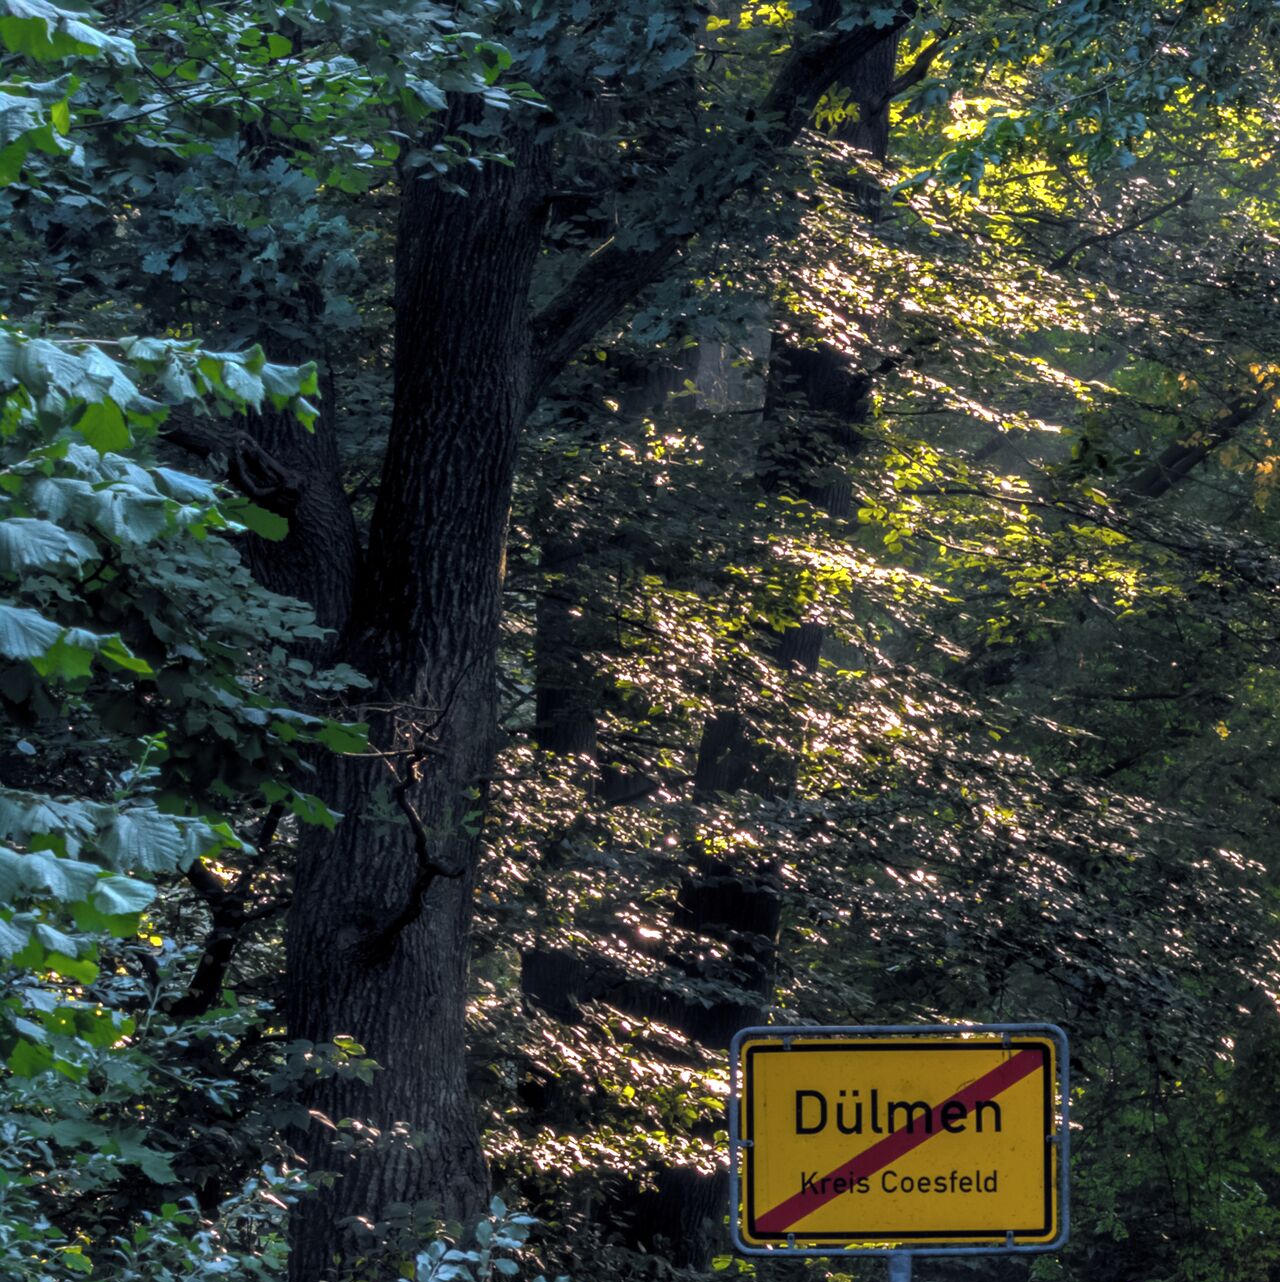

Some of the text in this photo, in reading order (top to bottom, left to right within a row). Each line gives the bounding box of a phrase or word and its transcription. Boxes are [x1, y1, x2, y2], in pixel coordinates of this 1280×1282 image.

[795, 1089, 1002, 1135] Dülmen
[800, 1170, 998, 1195] Kreis Coesfeld
